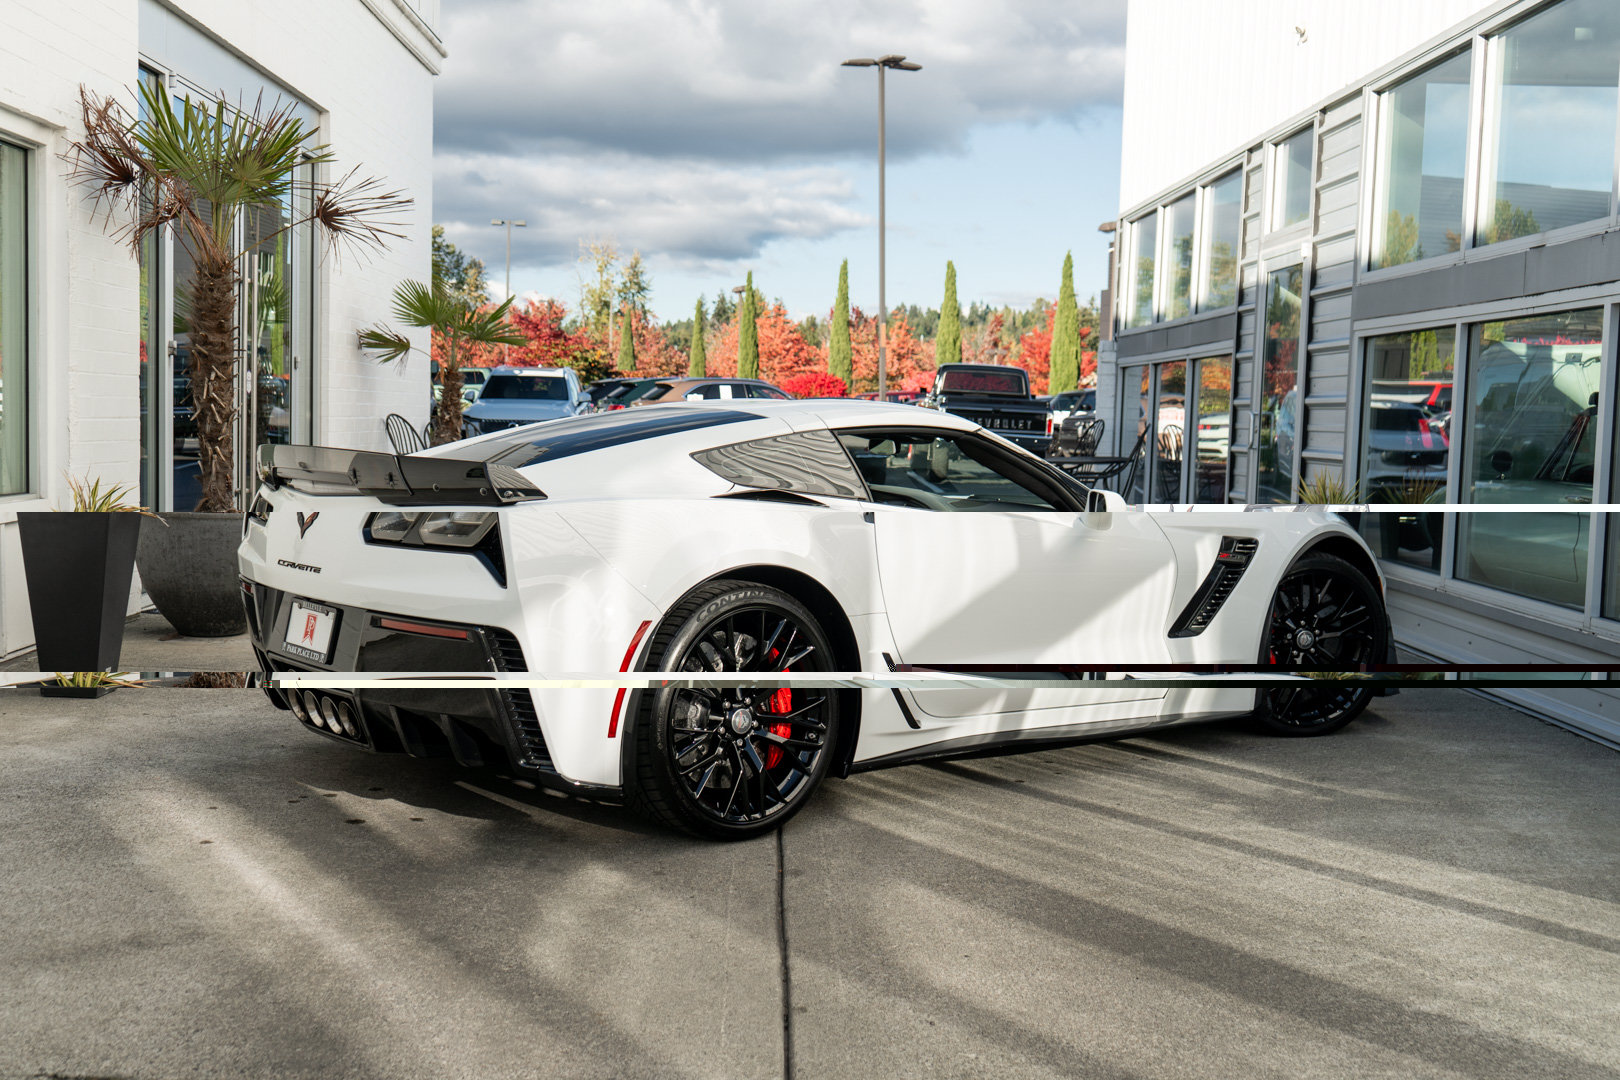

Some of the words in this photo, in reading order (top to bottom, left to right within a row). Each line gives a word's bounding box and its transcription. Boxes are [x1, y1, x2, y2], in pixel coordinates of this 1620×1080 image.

[968, 416, 1032, 430] EVROLET
[277, 559, 322, 574] CORVETTE
[286, 644, 297, 654] PARK
[297, 647, 310, 658] PLACE
[310, 651, 320, 661] LTD
